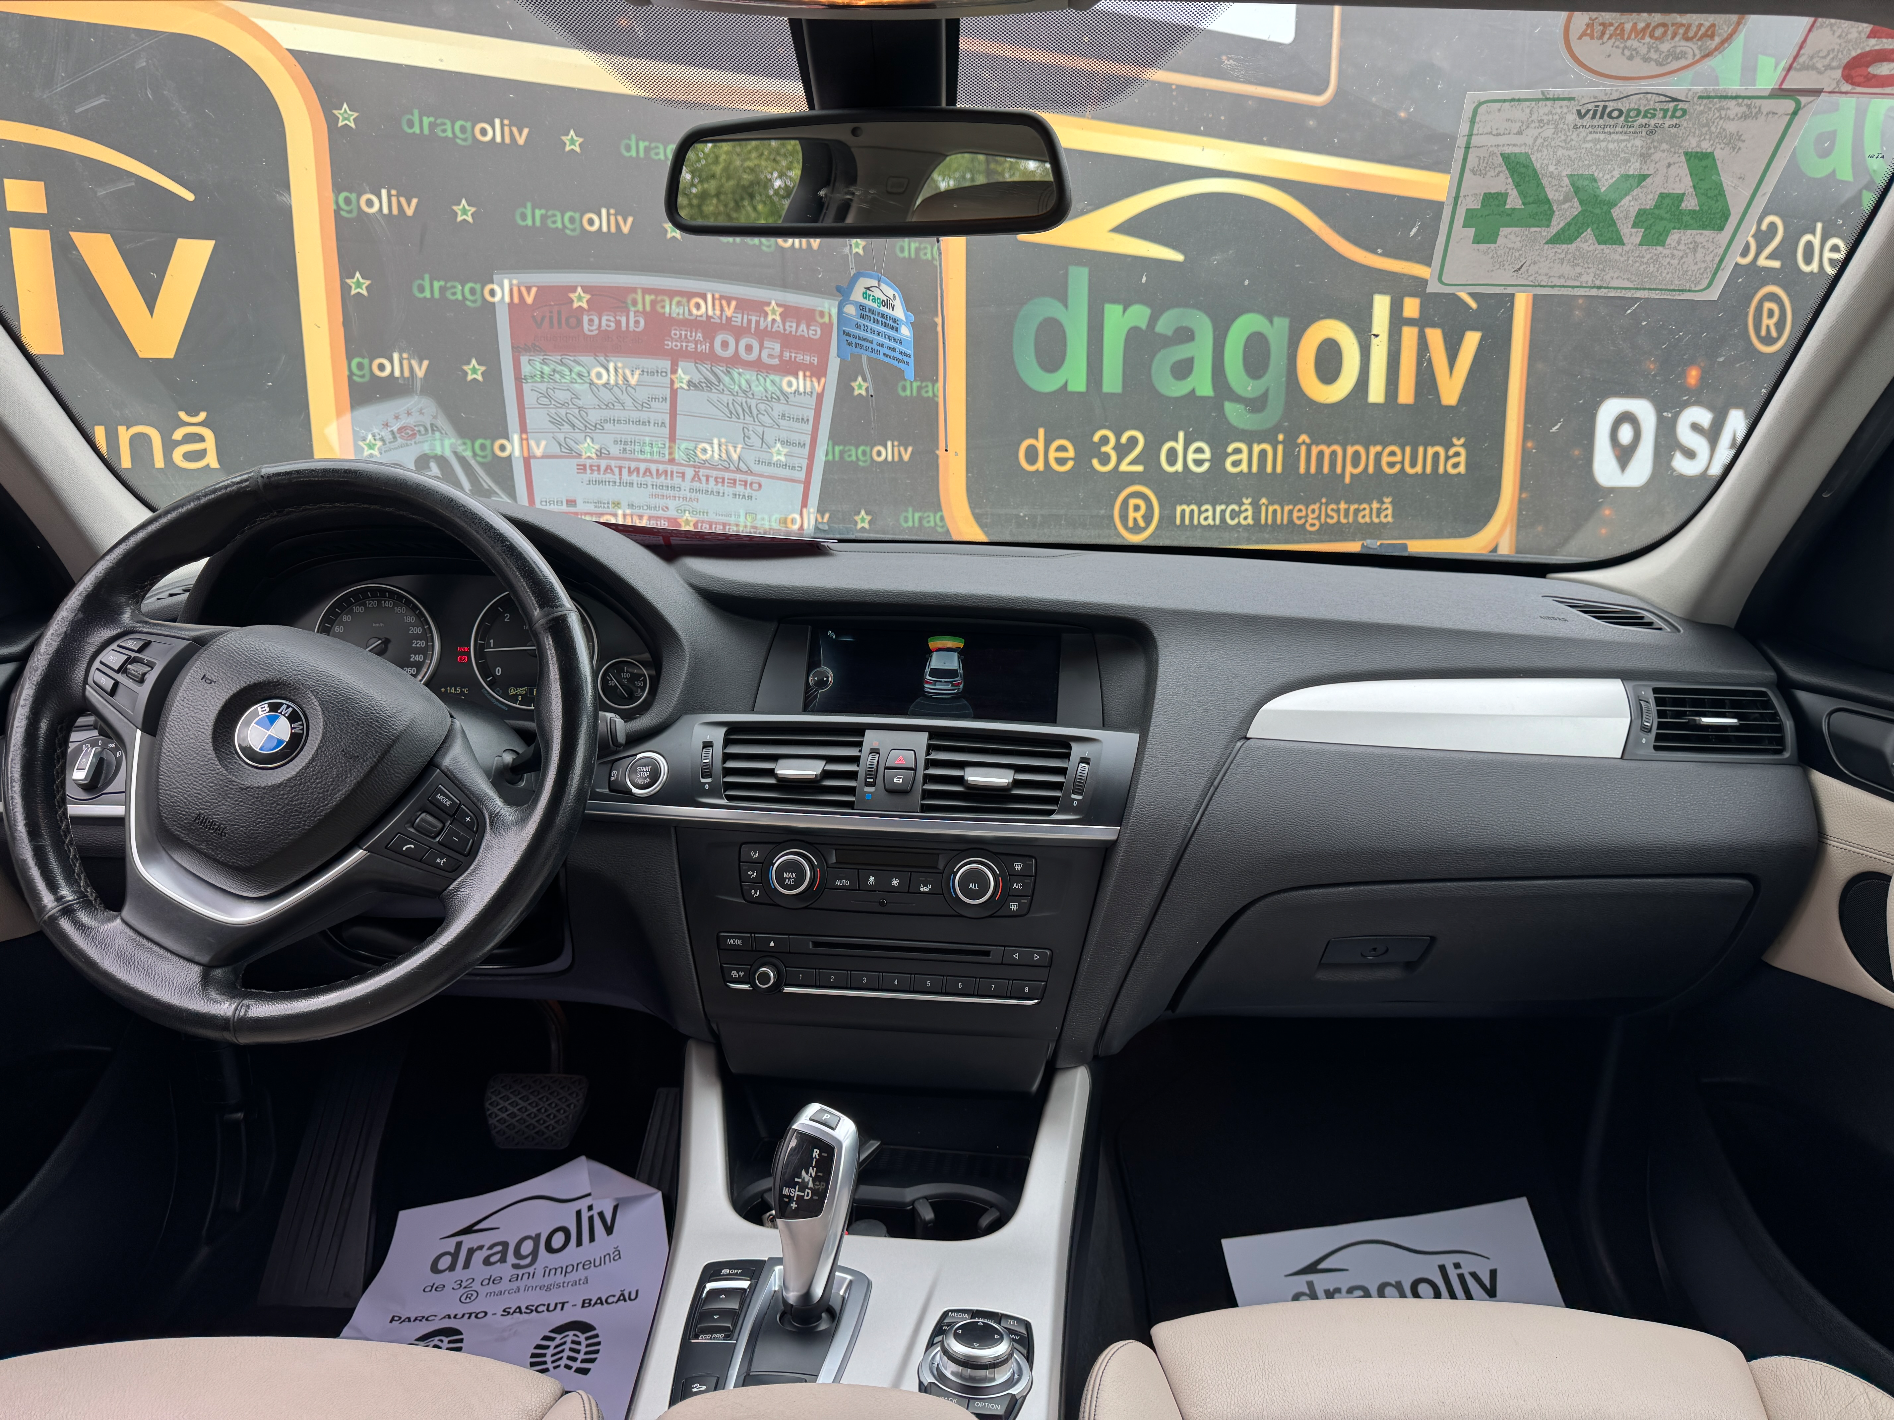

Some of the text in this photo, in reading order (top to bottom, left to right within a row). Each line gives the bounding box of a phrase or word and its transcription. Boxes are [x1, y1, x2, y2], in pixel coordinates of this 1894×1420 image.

[401, 109, 529, 146] dragoliv
[333, 188, 418, 218] goliv
[515, 202, 633, 236] dragoliv
[411, 274, 538, 307] dragoliv
[862, 289, 896, 311] dragoliv
[1012, 265, 1482, 431] dragoliv
[347, 352, 429, 383] goliv
[819, 440, 913, 465] dragoliv
[1017, 427, 1467, 485] de 32 de ani împreună
[1175, 497, 1253, 526] marcă
[1260, 496, 1394, 532] înregistrată
[353, 605, 365, 613] 100
[366, 600, 394, 608] 120 140
[334, 625, 423, 634] 60 200
[342, 613, 511, 623] 80 180 2
[495, 667, 502, 675] 0
[256, 703, 304, 734] BMW
[813, 1148, 820, 1159] R
[808, 1166, 817, 1178] N
[804, 1188, 812, 1200] D
[429, 1203, 620, 1276] dragoliv
[422, 1245, 622, 1294] de 32 de ani împreună
[484, 1285, 521, 1299] marcă
[388, 1289, 640, 1325] PARC AUTO SASCUT BACĂU
[974, 1398, 1001, 1411] OPTION
